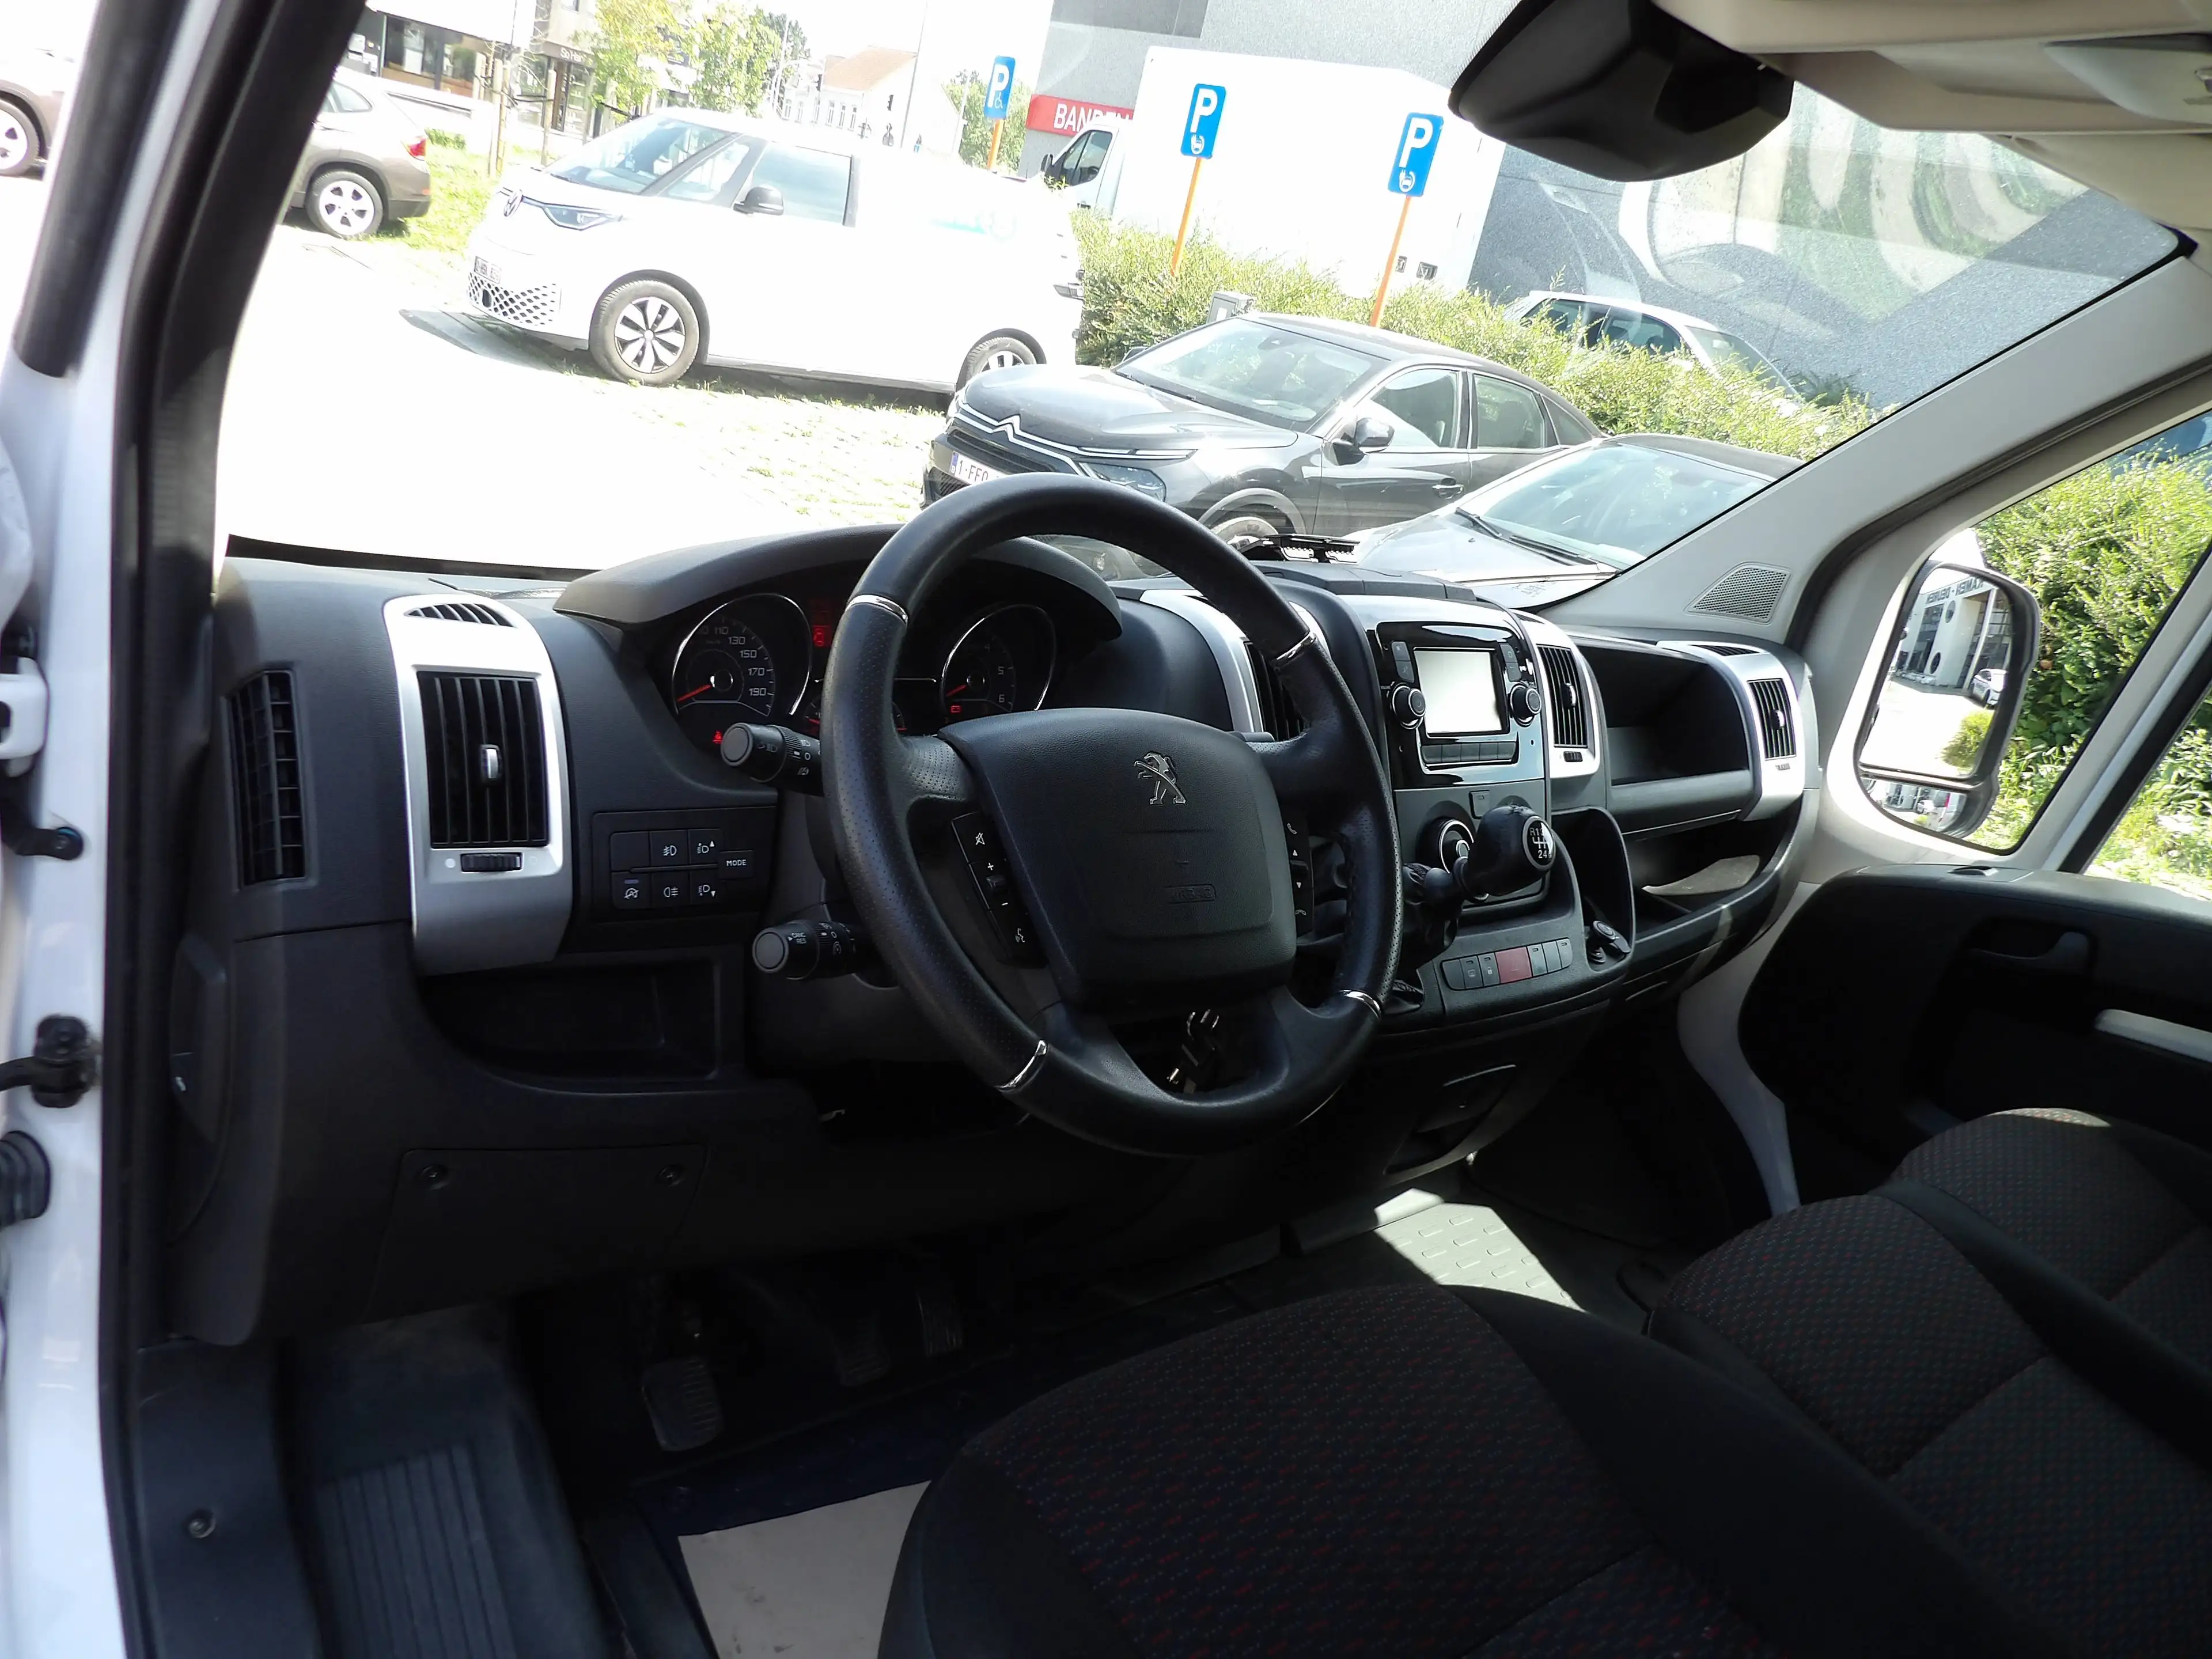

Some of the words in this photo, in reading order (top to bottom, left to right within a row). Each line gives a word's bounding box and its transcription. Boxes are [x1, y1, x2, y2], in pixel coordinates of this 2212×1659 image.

[987, 65, 1009, 108] P
[1190, 88, 1218, 133] P
[1054, 103, 1130, 132] BAN
[1399, 118, 1433, 168] P
[728, 636, 745, 645] 130
[740, 650, 757, 658] 150
[748, 668, 765, 676] 170
[998, 666, 1004, 675] 5
[749, 688, 767, 696] 190
[998, 694, 1005, 703] 6
